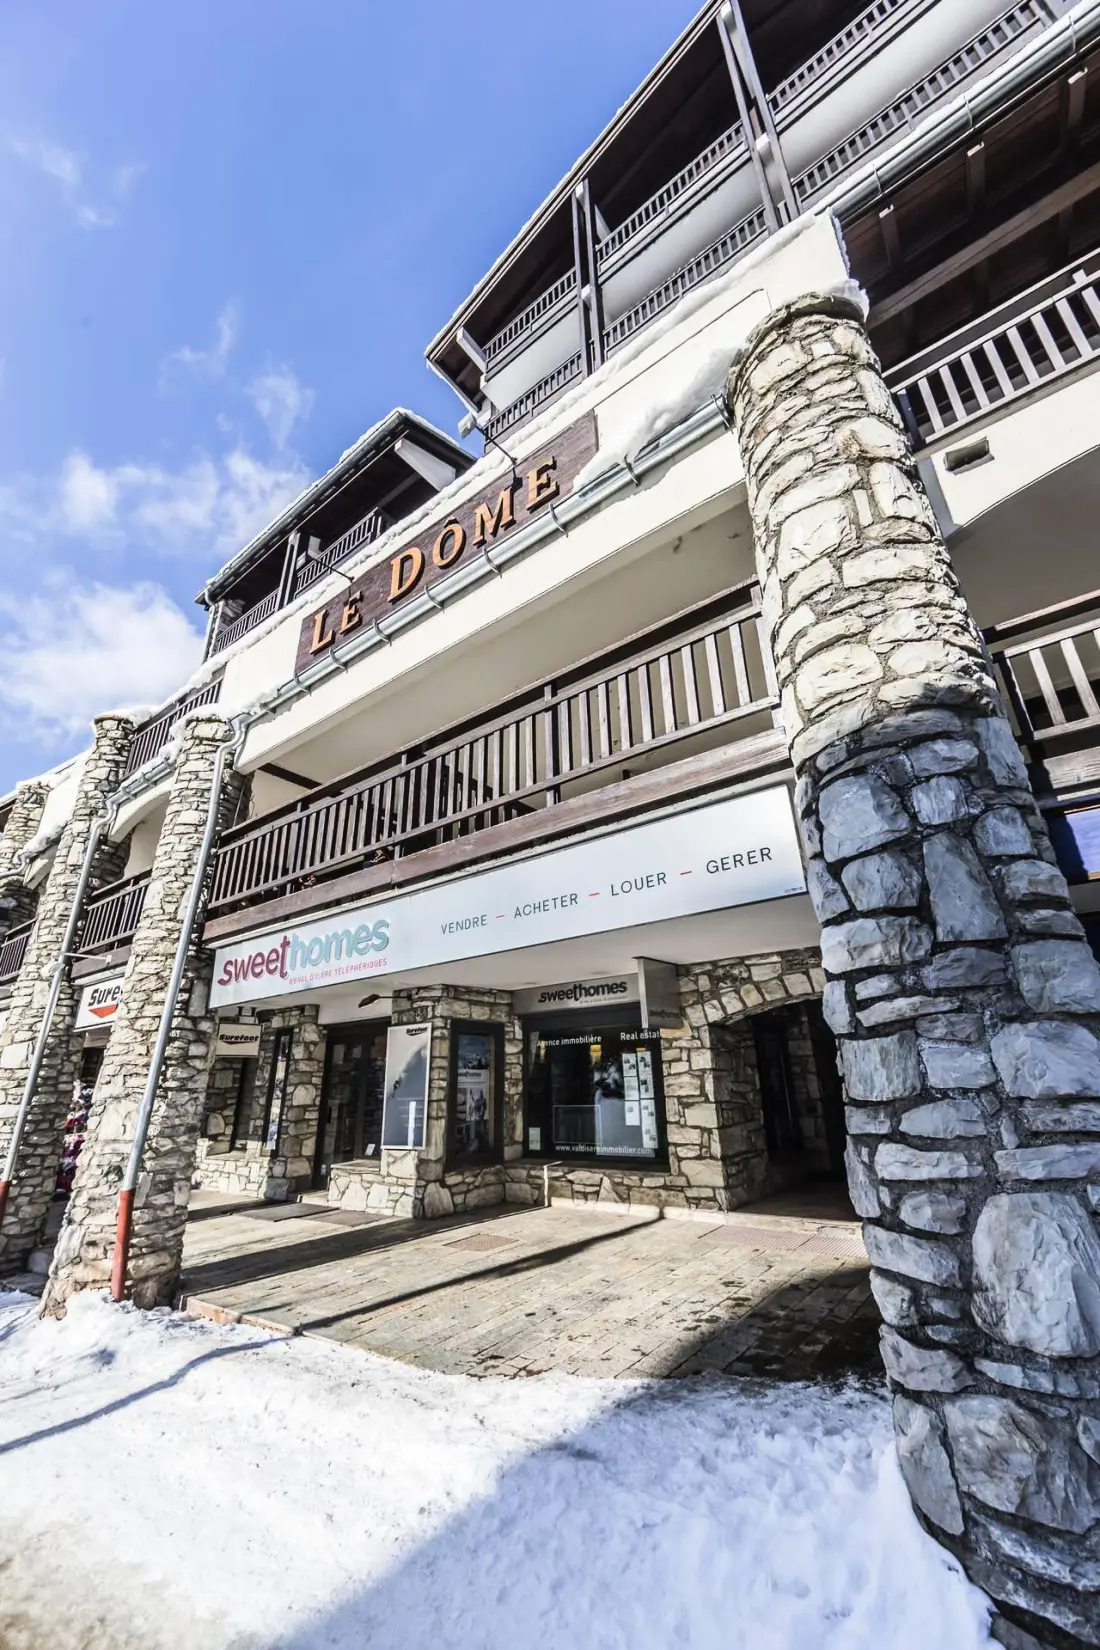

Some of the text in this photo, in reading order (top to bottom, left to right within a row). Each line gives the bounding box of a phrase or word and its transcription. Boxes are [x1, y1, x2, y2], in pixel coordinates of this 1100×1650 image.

[309, 456, 561, 656] LE DÔME
[440, 846, 773, 935] VENDRE ACHETER LOUER GERER
[217, 919, 390, 986] sweethomes
[88, 985, 123, 1006] Sure
[538, 981, 628, 1003] sweethomes
[219, 1033, 259, 1041] Surefoot
[560, 1034, 602, 1046] immobilière
[620, 1030, 660, 1041] Real estat
